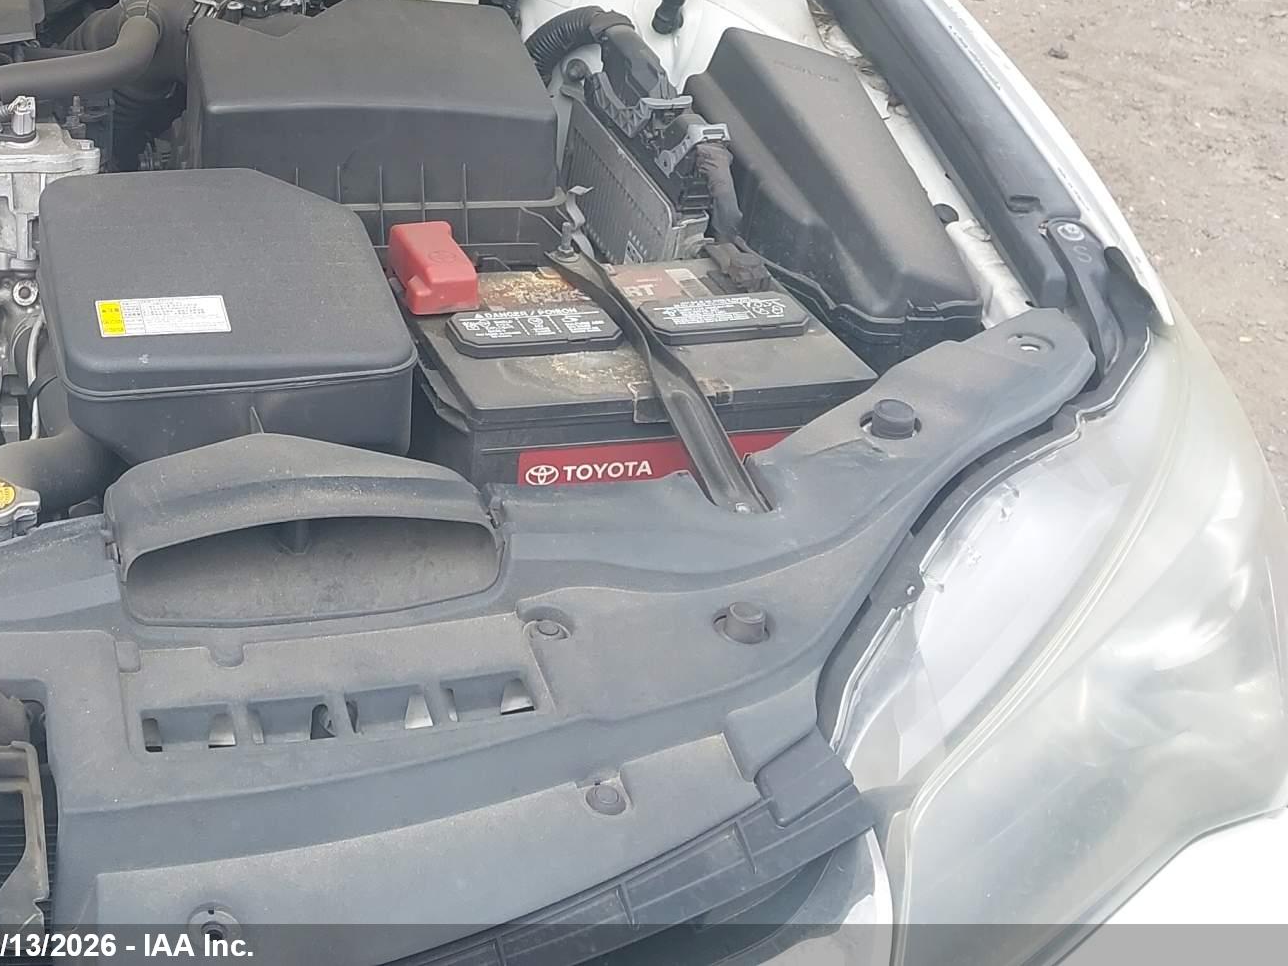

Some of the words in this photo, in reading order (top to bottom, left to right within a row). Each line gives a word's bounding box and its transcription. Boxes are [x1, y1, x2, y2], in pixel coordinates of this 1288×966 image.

[484, 310, 529, 319] DANGER
[537, 307, 578, 316] POISON
[562, 460, 653, 482] TOYOTA
